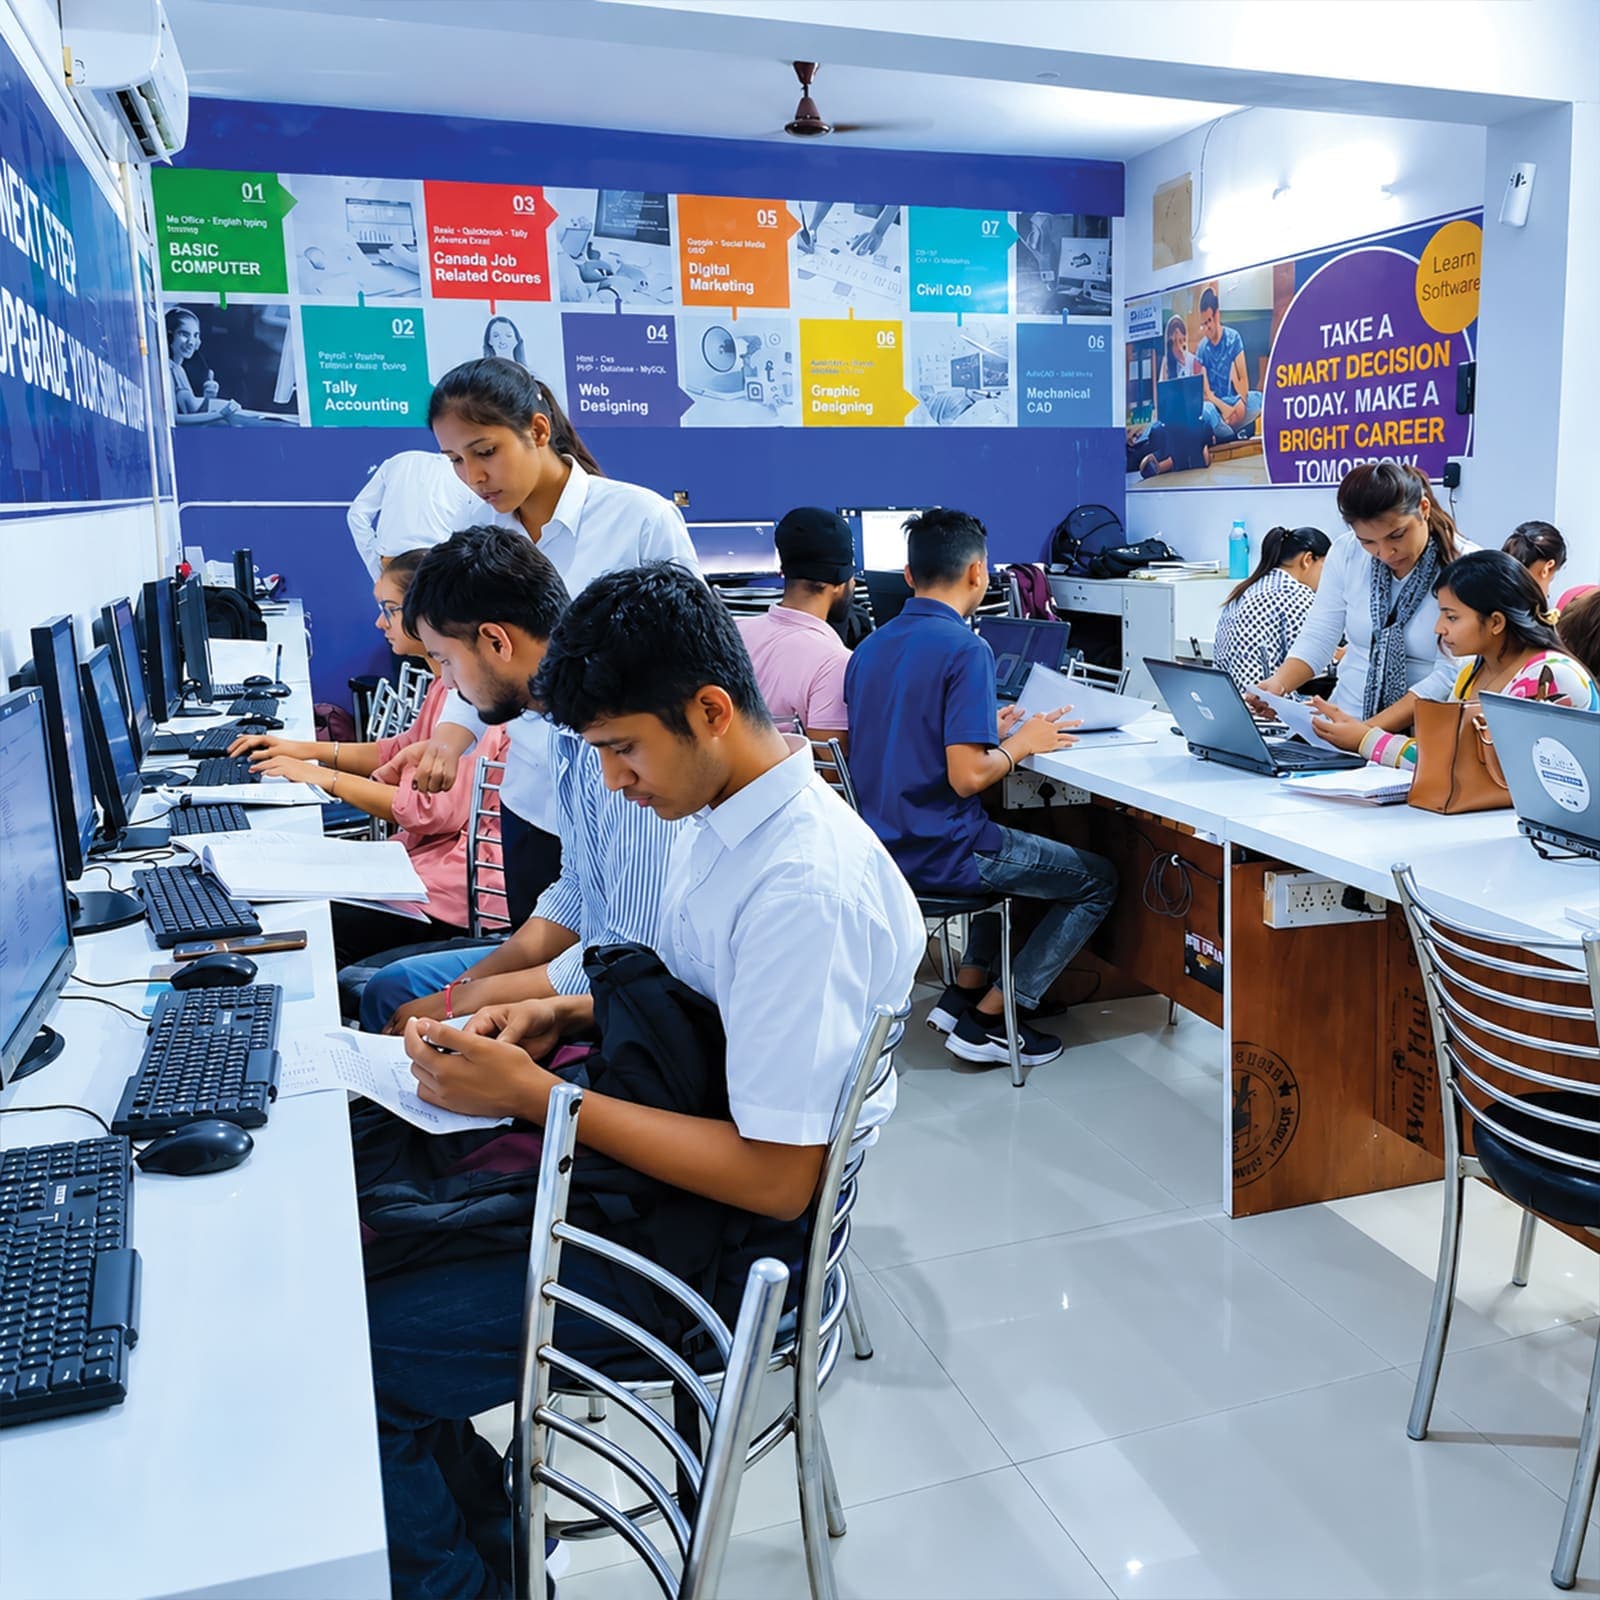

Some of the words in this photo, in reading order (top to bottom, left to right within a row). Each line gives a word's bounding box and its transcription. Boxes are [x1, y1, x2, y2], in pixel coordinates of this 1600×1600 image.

[241, 182, 265, 200] 01
[512, 195, 535, 212] 03
[757, 209, 777, 225] 05
[0, 157, 45, 270] NEXT
[42, 202, 77, 297] STEP
[981, 220, 1000, 235] 07
[169, 242, 219, 257] BASIC
[434, 251, 487, 266] Canada
[491, 254, 517, 267] Job
[1433, 251, 1476, 273] Learn
[171, 260, 261, 275] COMPUTER
[689, 262, 730, 278] Digital
[435, 268, 488, 282] Related
[491, 270, 542, 284] Coures
[690, 278, 754, 295] Marketing
[916, 283, 943, 297] Civil
[945, 284, 972, 297] CAD
[1422, 277, 1481, 301] Software
[392, 318, 415, 335] 02
[646, 325, 668, 340] 04
[1320, 316, 1373, 348] TAKE
[1377, 313, 1394, 340] A
[876, 330, 896, 345] 06
[1088, 335, 1105, 349] 06
[1276, 357, 1341, 388] SMART
[1346, 340, 1451, 380] DECISION
[67, 333, 101, 414] YOUR
[322, 380, 357, 397] Tally
[578, 383, 609, 396] Web
[811, 384, 860, 398] Graphic
[1027, 387, 1090, 399] Mechanical
[325, 397, 409, 415] Accounting
[580, 399, 648, 415] Designing
[812, 400, 873, 415] Designing
[1027, 402, 1052, 413] CAD
[1282, 390, 1348, 420] TODAY.
[1355, 382, 1417, 413] MAKE
[1422, 380, 1440, 407] A
[1279, 424, 1349, 452] BRIGHT
[1354, 416, 1445, 448] CAREER
[1294, 454, 1418, 484] TOMO
